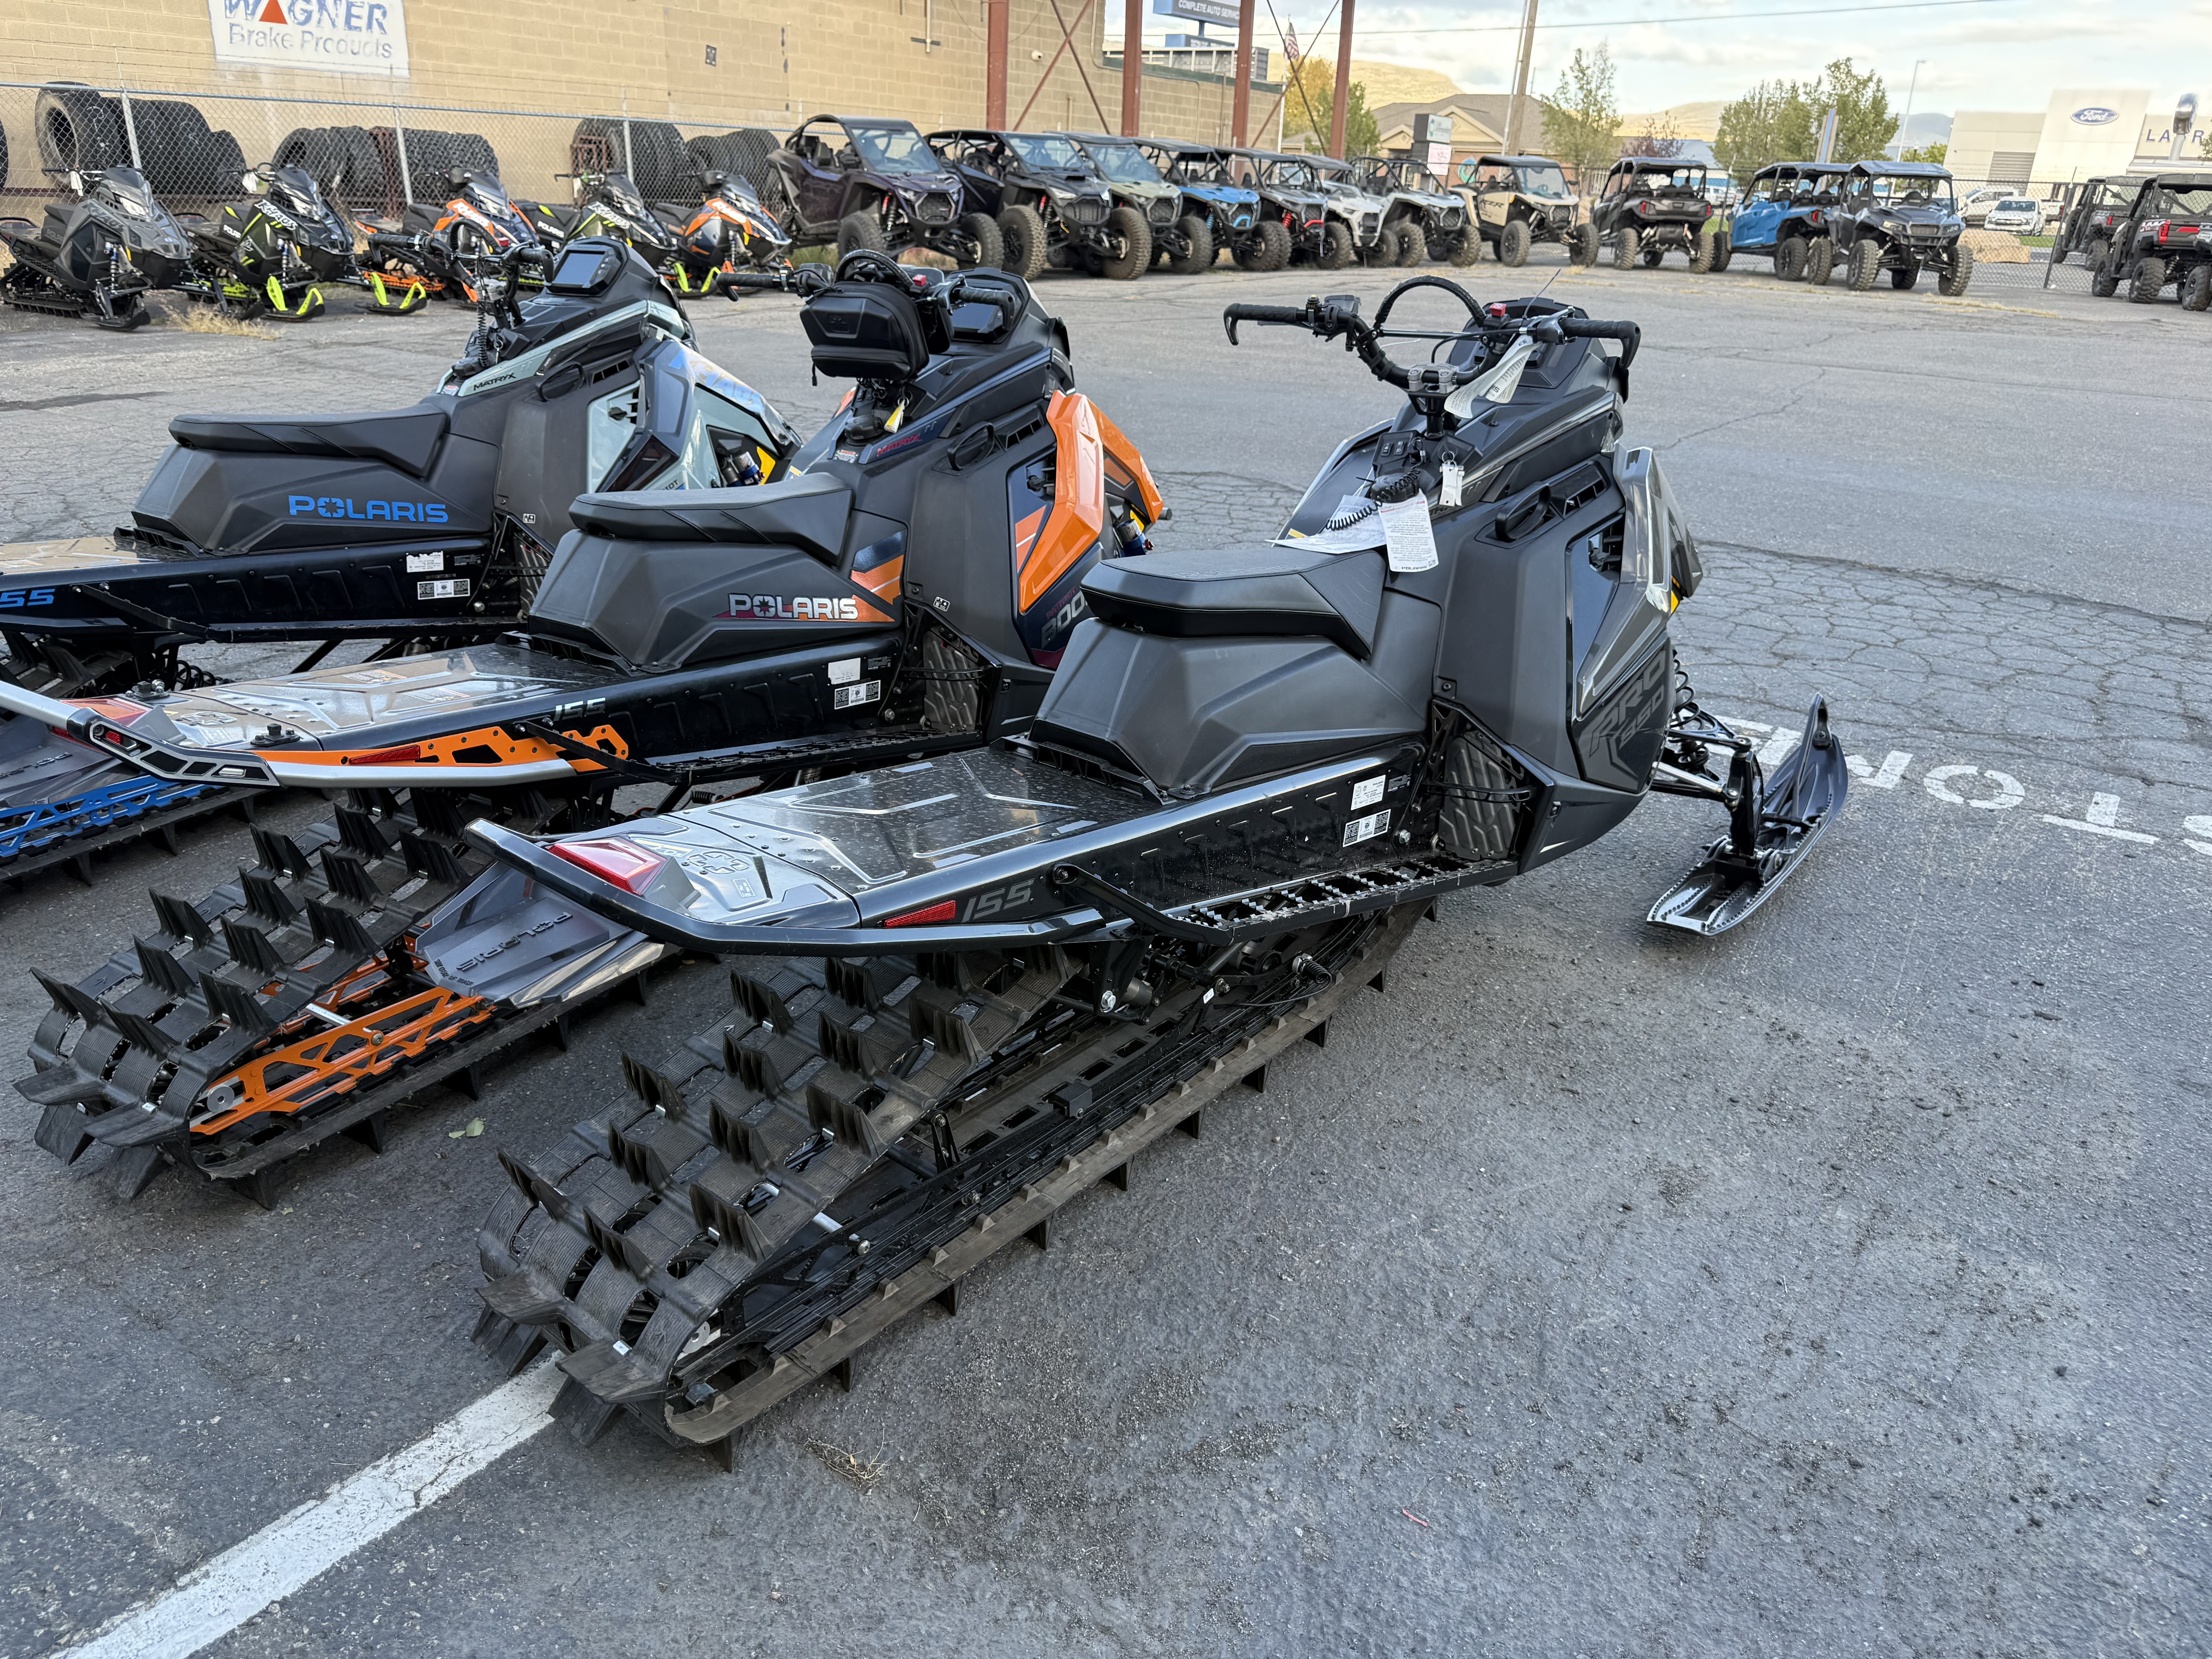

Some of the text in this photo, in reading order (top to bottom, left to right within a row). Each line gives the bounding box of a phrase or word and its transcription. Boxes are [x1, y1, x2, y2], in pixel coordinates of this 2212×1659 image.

[1178, 0, 1240, 20] COMPLETE AUTO SERVIC
[229, 22, 392, 58] Brake Products
[474, 373, 517, 391] MATRYX
[877, 433, 922, 457] MATRYX
[289, 495, 448, 523] POLARIS
[728, 593, 859, 620] POLARIS
[1046, 586, 1076, 618] PATRIOT
[553, 697, 606, 721] 155
[1589, 650, 1666, 758] PRO
[1618, 684, 1664, 750] 850
[962, 878, 1035, 923] 155
[456, 911, 574, 971] POLARIS
